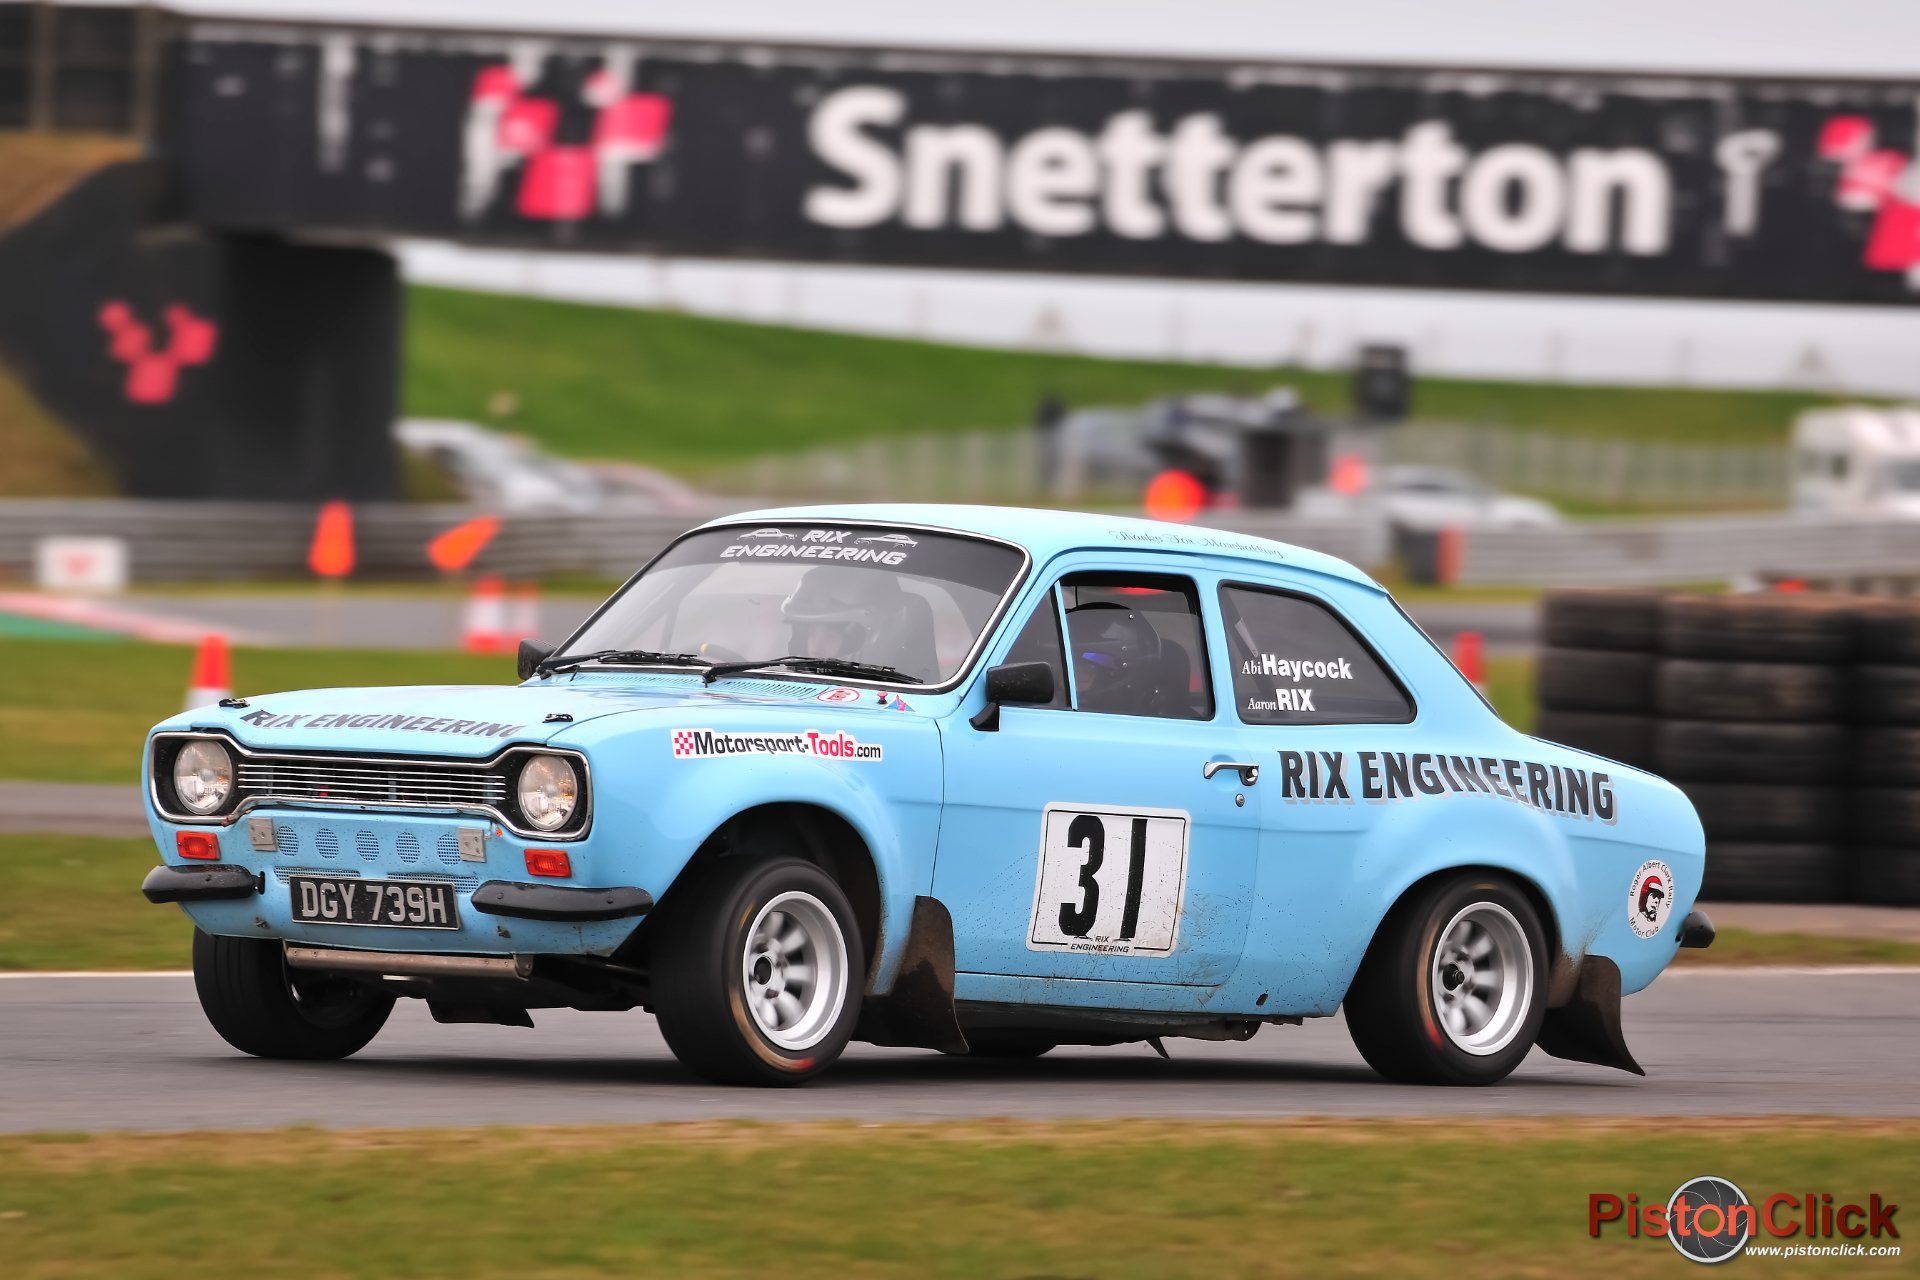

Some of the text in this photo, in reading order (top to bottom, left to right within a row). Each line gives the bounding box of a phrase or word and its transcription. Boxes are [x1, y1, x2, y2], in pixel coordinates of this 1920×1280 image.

[804, 86, 1672, 255] Snetterton
[801, 530, 851, 543] RIX
[720, 545, 907, 565] ENGINEERING
[1241, 653, 1353, 682] Abi Haycock
[1248, 688, 1316, 711] Aaron RIX
[239, 709, 311, 728] RIX
[1278, 751, 1617, 826] RIX ENGINEERING
[1058, 814, 1148, 938] 31
[1629, 871, 1642, 897] Roger
[1642, 861, 1660, 873] Albert
[1660, 864, 1673, 884] Clark
[300, 881, 448, 924] DGY 739H
[1629, 916, 1659, 937] Motor Club
[1070, 943, 1130, 953] ENGINEERING
[1095, 935, 1110, 943] RIX
